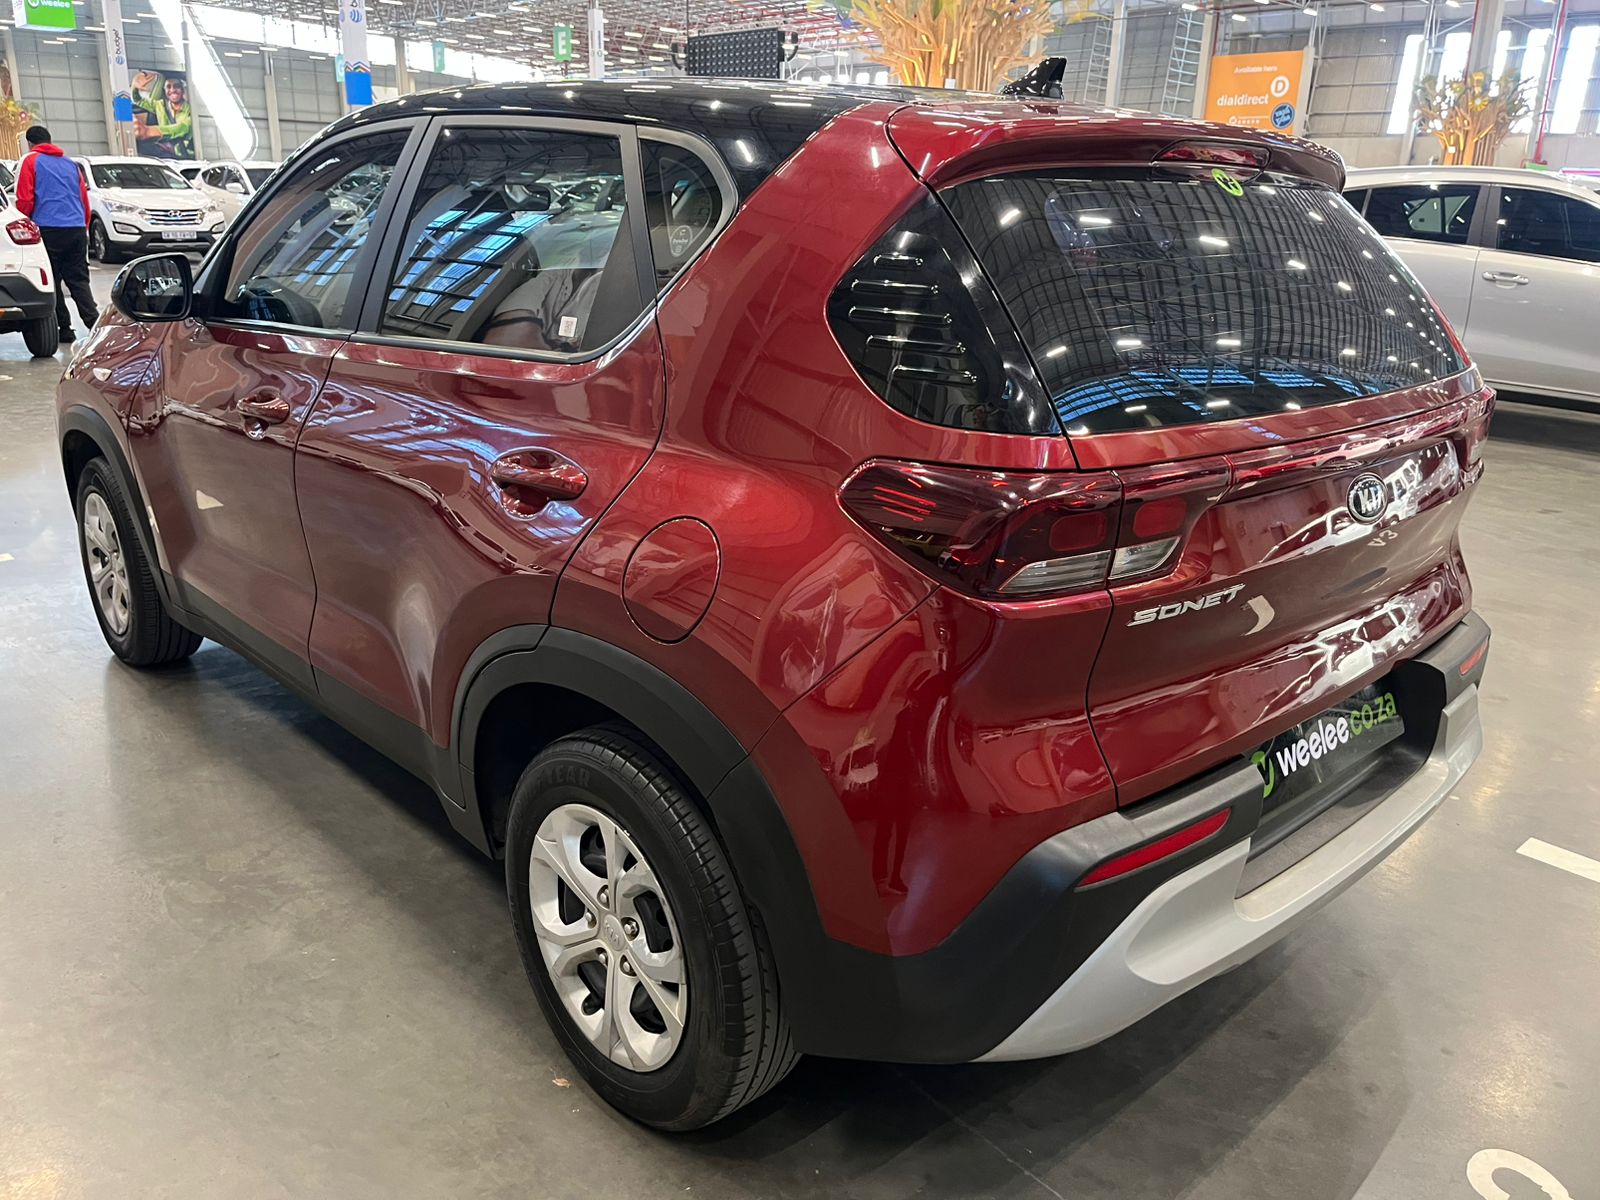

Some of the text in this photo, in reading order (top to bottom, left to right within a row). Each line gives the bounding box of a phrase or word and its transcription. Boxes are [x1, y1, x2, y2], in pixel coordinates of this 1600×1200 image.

[558, 31, 567, 55] E
[1217, 94, 1269, 106] dialdirect
[1126, 583, 1246, 627] SONET
[1276, 692, 1397, 777] weelee.co.za
